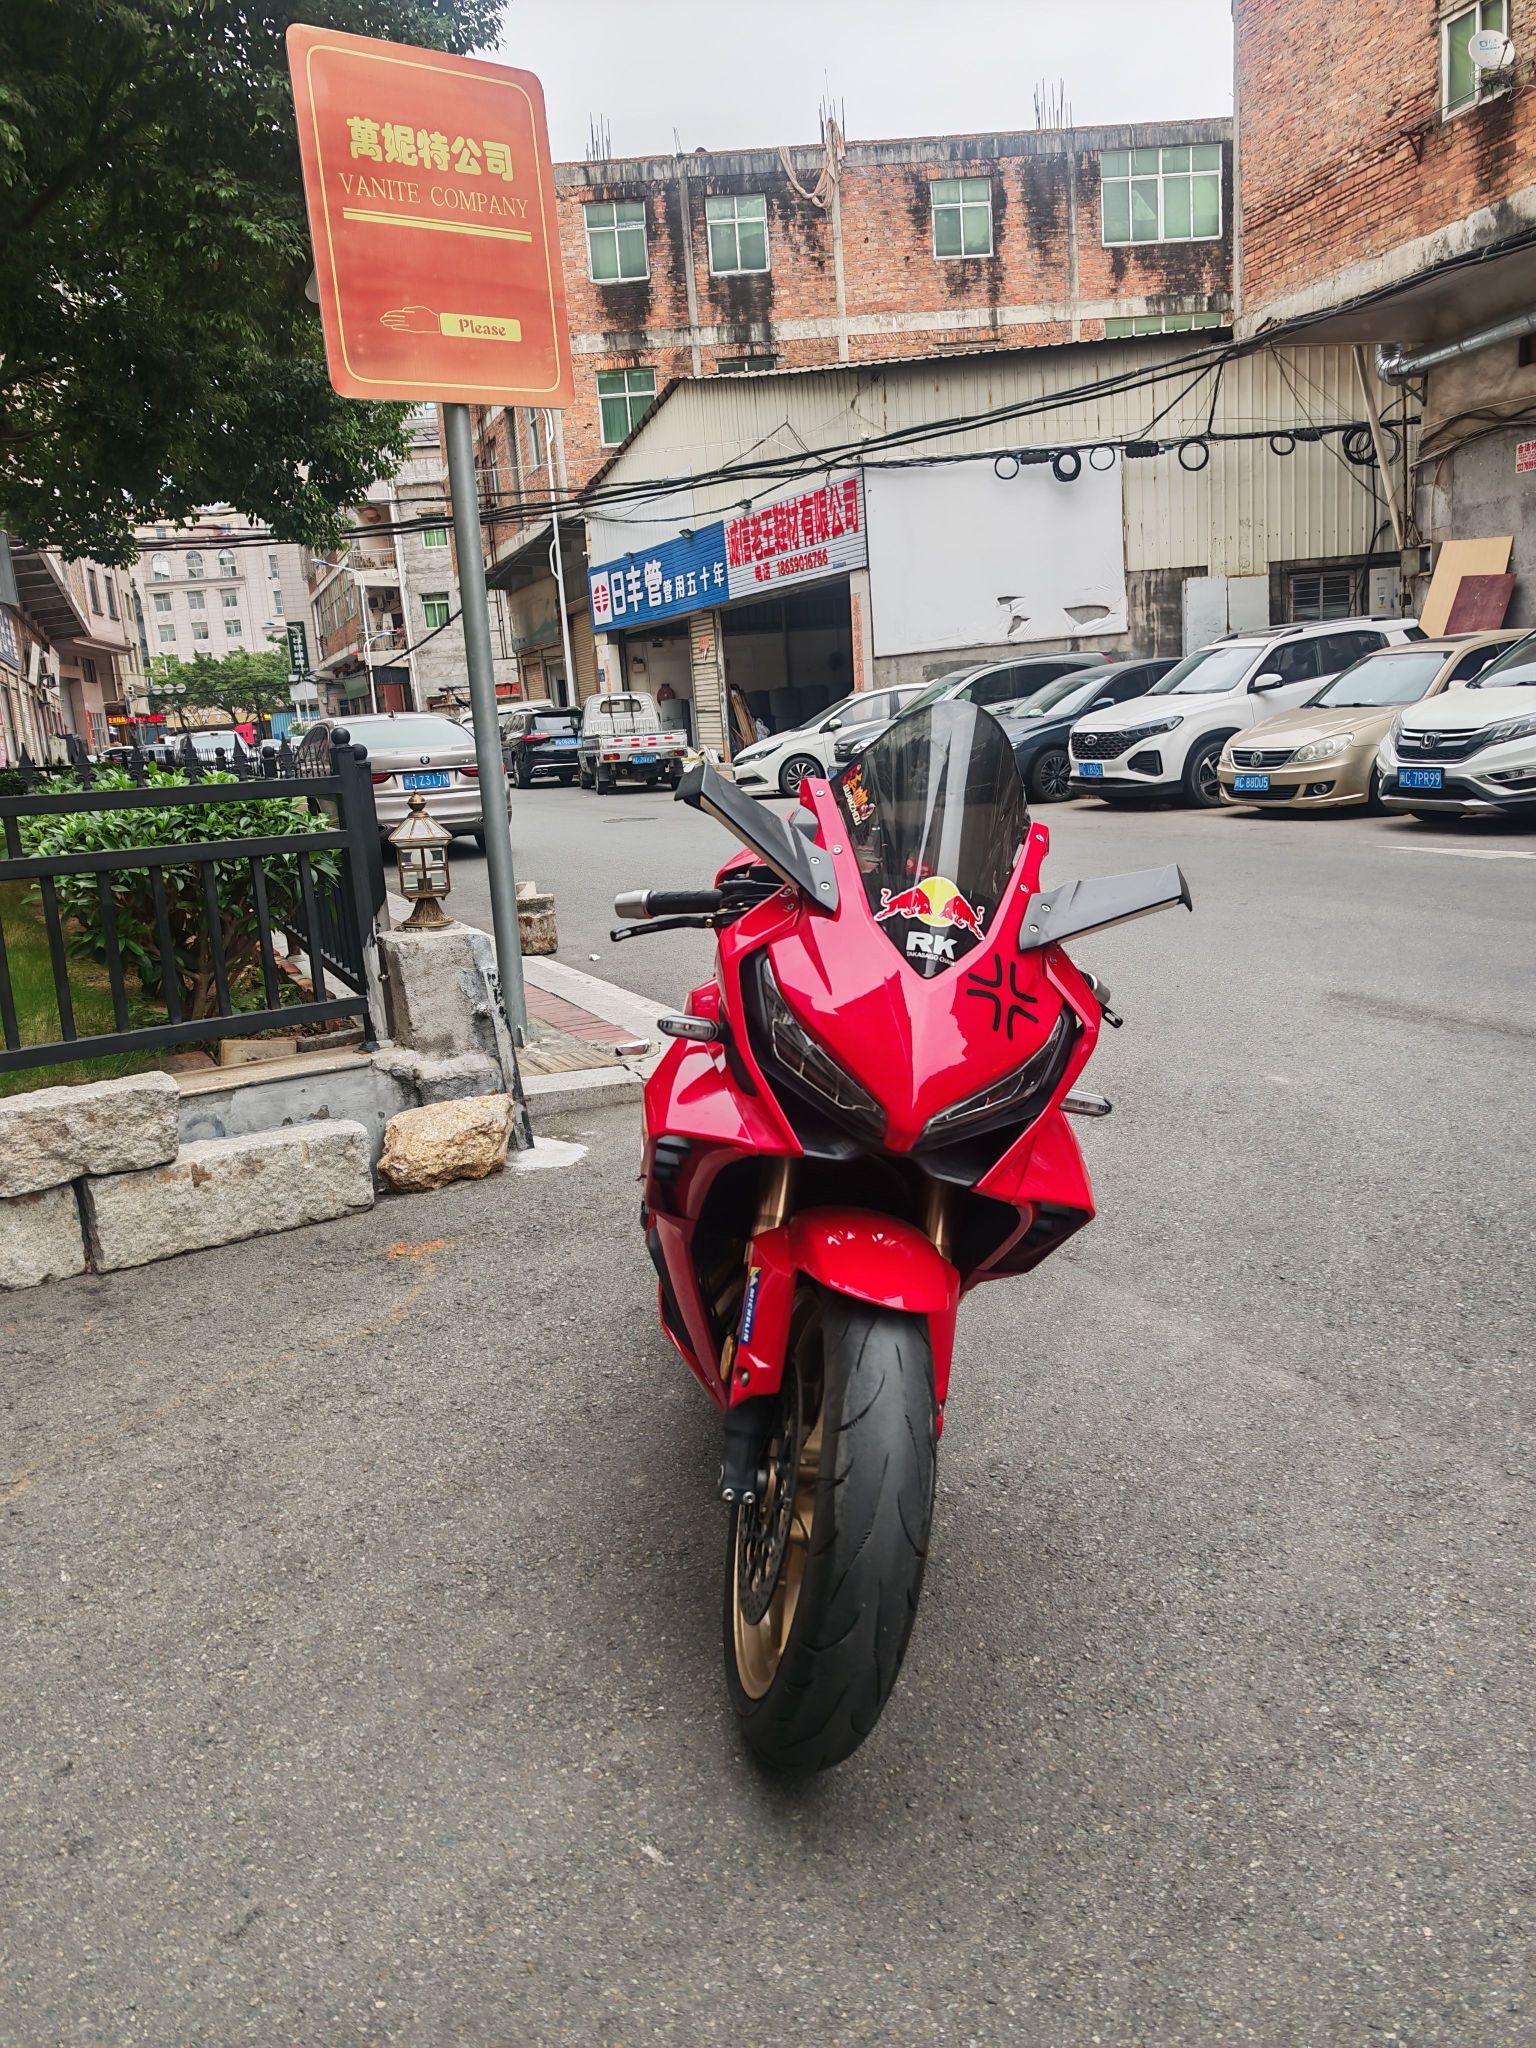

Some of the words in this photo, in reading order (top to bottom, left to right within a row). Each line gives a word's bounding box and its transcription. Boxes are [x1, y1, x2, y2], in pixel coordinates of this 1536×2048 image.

[346, 116, 514, 182] 萬妮特公司
[338, 172, 421, 204] VANITE
[430, 185, 529, 219] COMPANY
[458, 317, 506, 337] Please
[610, 559, 663, 617] 日丰管
[662, 561, 725, 604] 管用五十年
[906, 931, 958, 960] RK
[743, 1288, 755, 1342] MICHELIN
